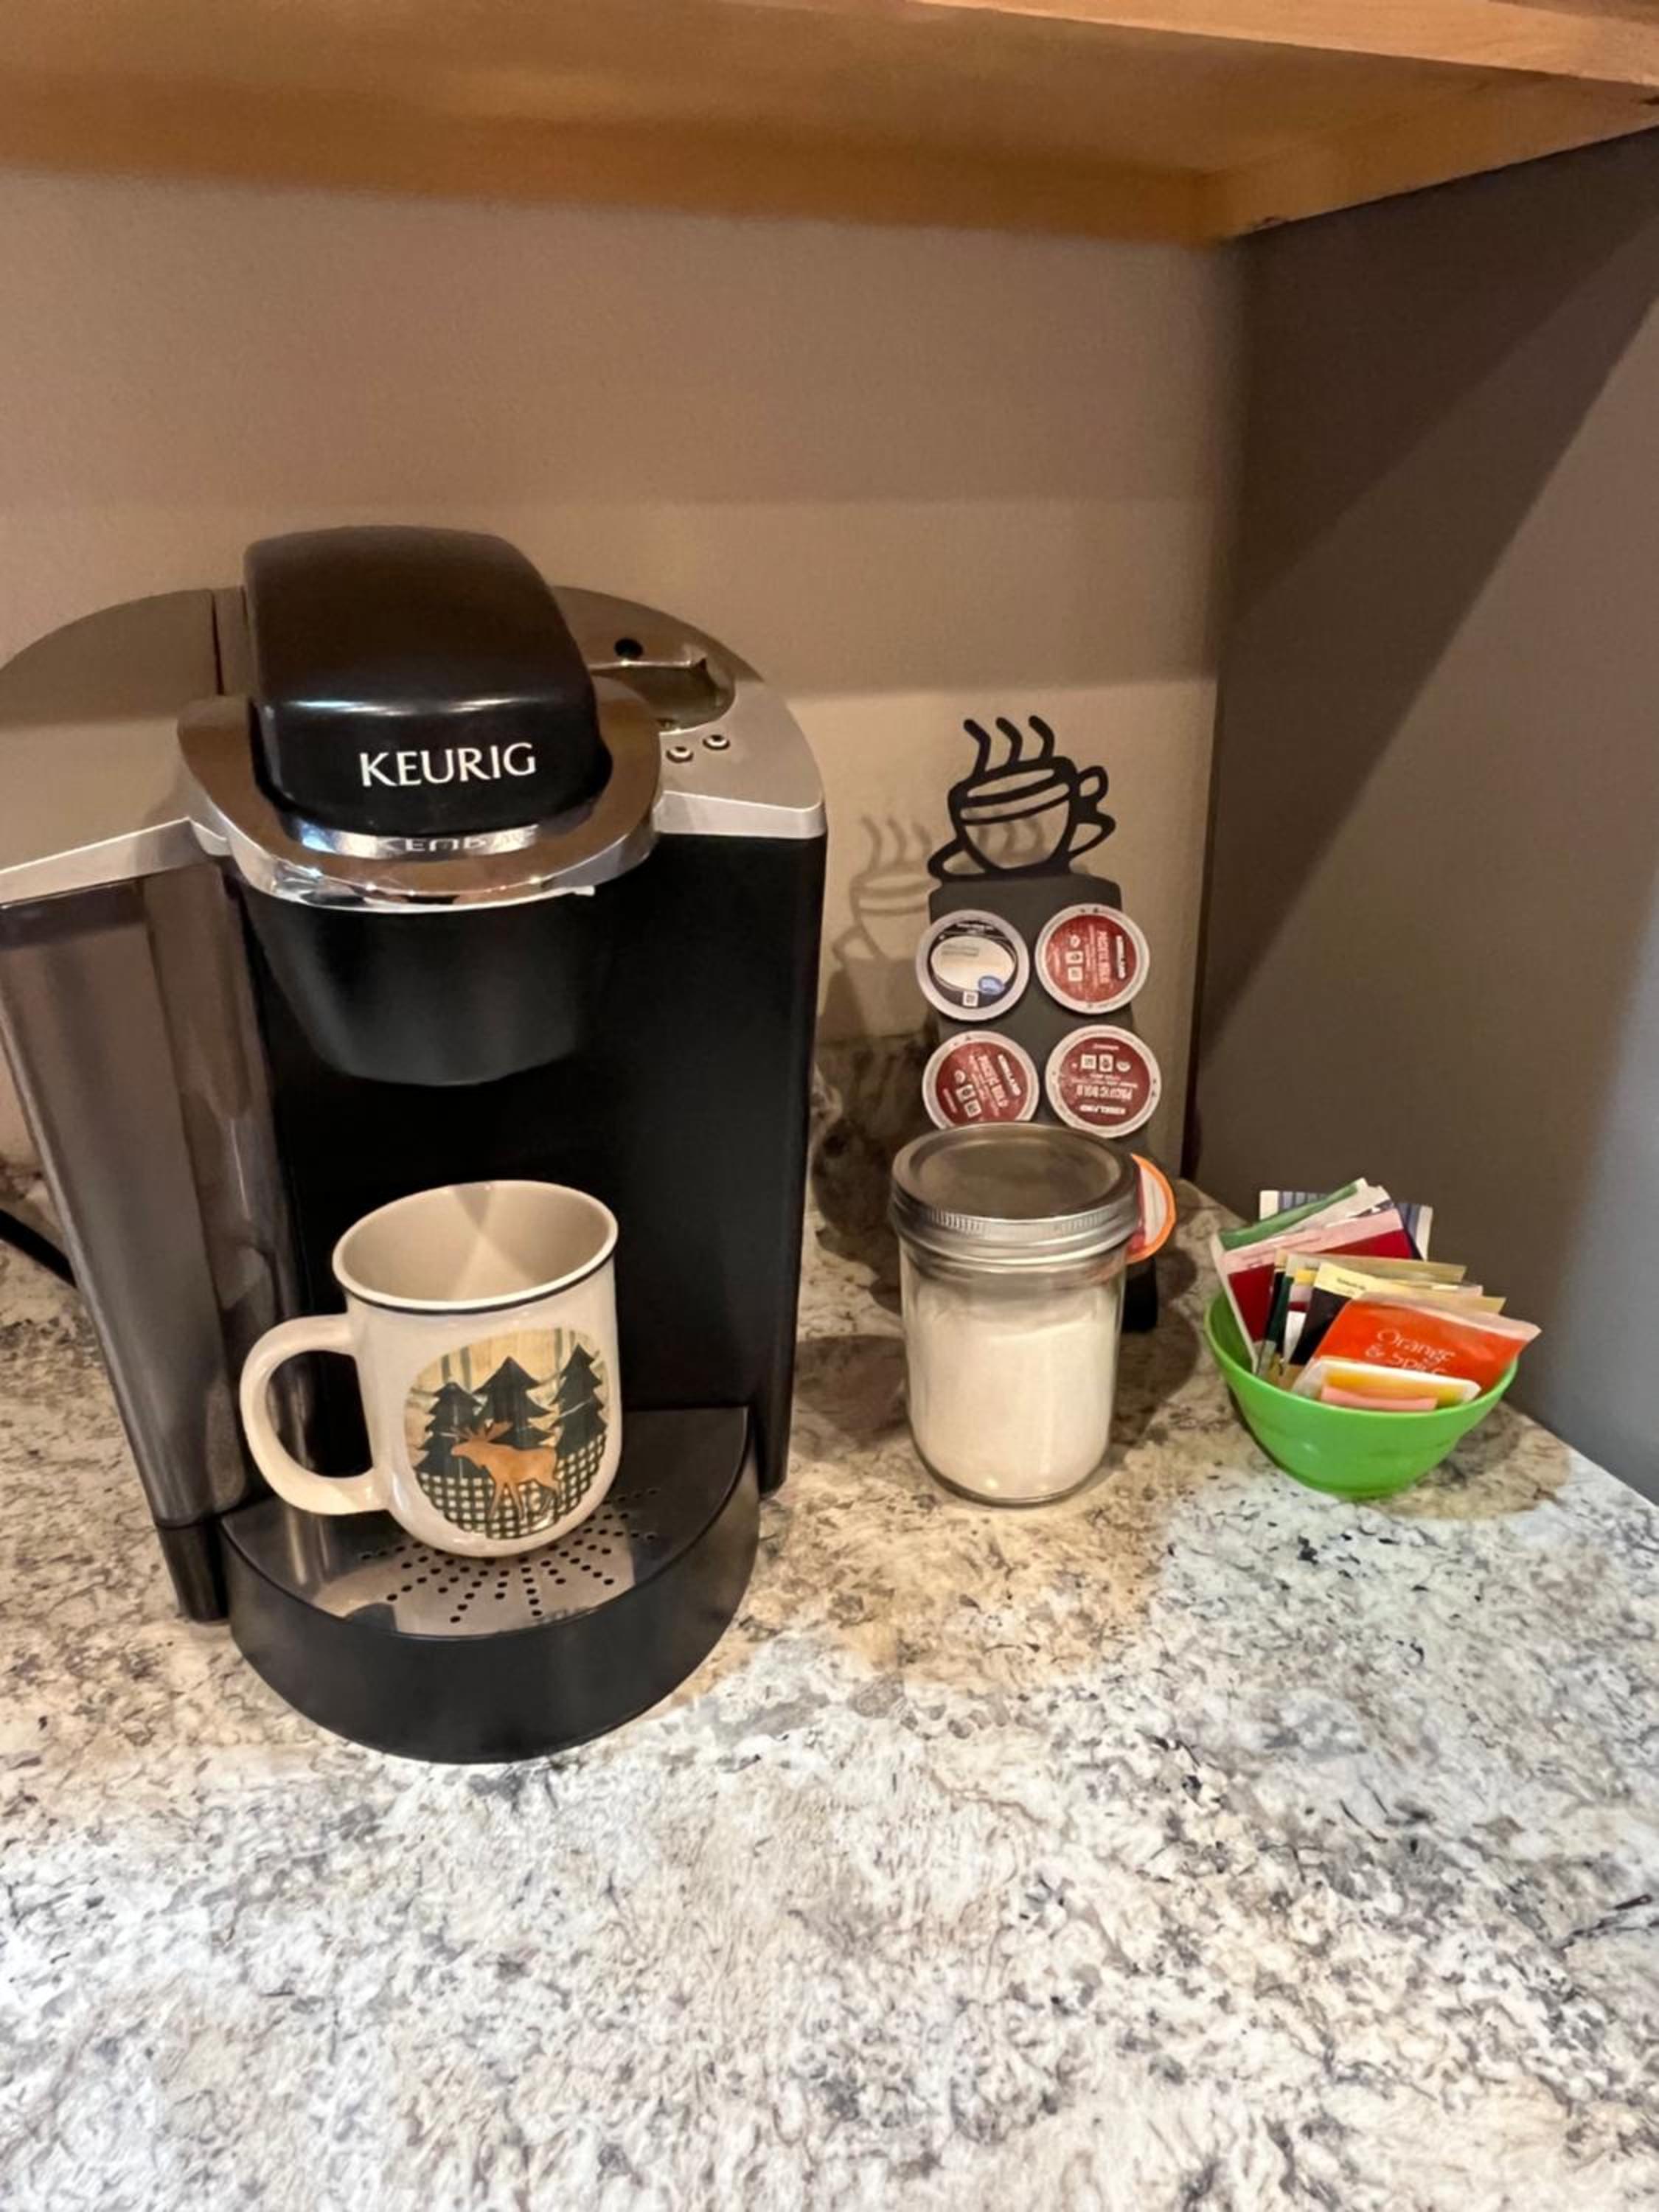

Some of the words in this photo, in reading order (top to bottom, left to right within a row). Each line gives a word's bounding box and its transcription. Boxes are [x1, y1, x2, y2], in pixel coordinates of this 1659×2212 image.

[359, 742, 537, 787] KEURIG
[1365, 1342, 1385, 1358] &
[1377, 1327, 1456, 1366] Orange
